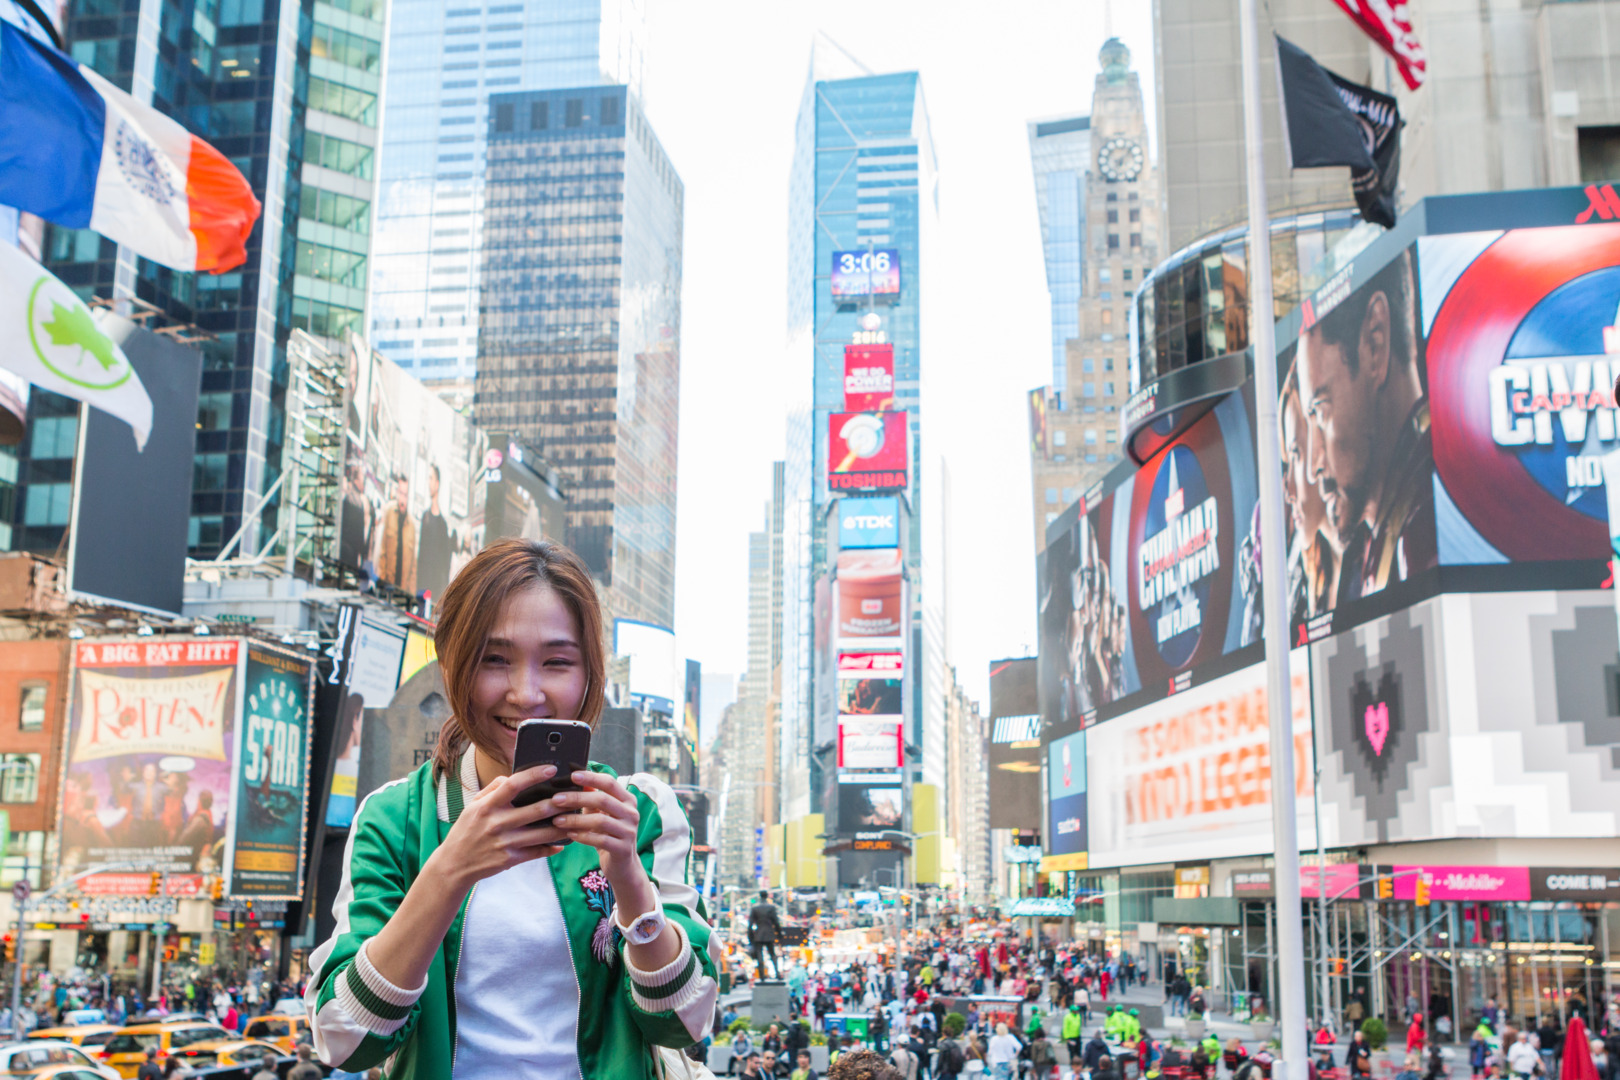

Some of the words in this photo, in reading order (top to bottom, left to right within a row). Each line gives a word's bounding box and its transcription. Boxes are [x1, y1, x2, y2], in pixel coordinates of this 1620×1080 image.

[840, 252, 890, 274] 3:06
[852, 331, 886, 344] 2016
[485, 469, 502, 482] LG
[1565, 456, 1603, 488] NO
[829, 473, 907, 488] TOSHIBA
[854, 515, 893, 529] TDK
[145, 643, 183, 661] FAT
[249, 678, 303, 720] BRIGHT
[245, 714, 301, 787] STAR
[856, 832, 883, 840] SONY
[1546, 874, 1590, 890] COME
[1590, 874, 1606, 890] IN
